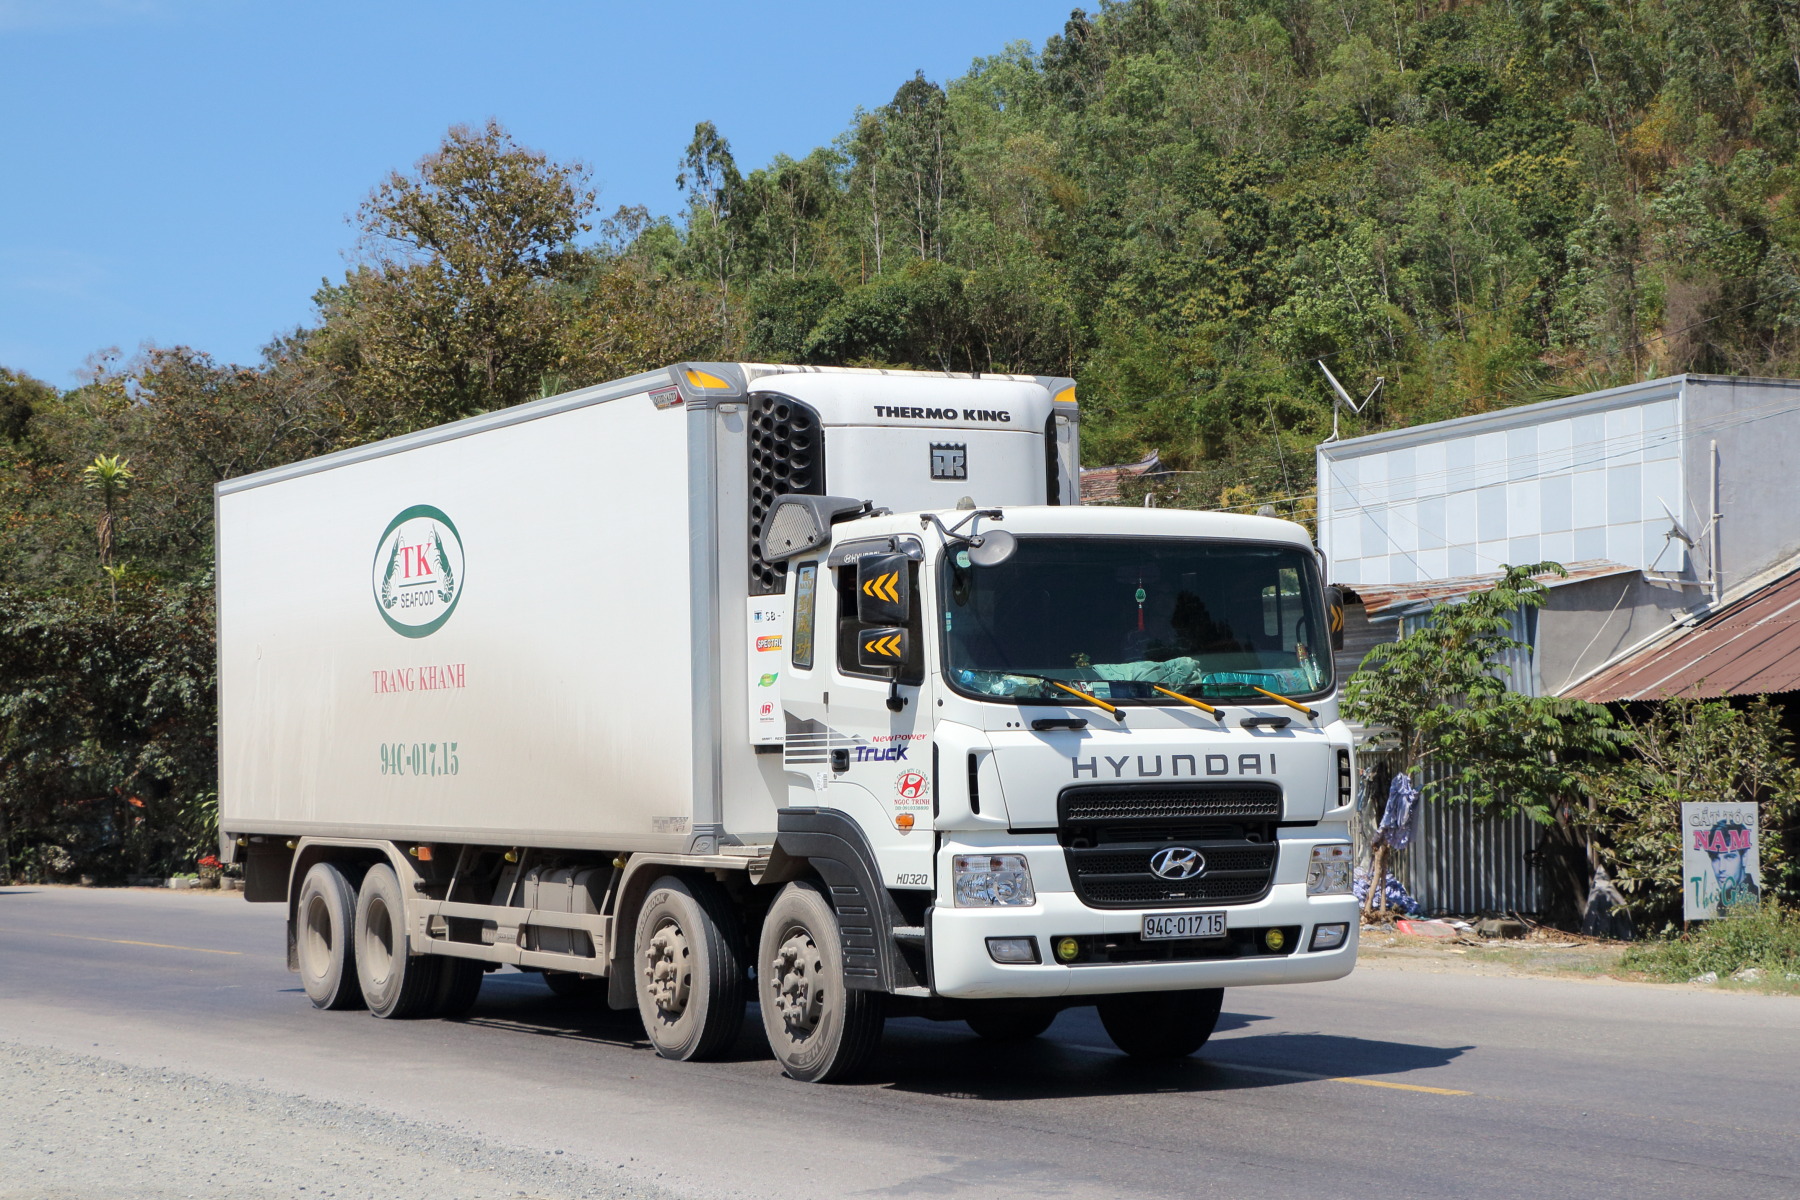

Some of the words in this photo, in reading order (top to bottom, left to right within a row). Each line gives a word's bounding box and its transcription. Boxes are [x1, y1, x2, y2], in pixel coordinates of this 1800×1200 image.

[874, 406, 958, 420] THERMO
[963, 409, 1011, 422] KING
[400, 543, 433, 578] TK
[401, 590, 435, 608] SEAFOOD
[373, 668, 414, 693] TRANG
[419, 664, 465, 690] KHANH
[761, 704, 772, 714] IR
[380, 742, 459, 777] 94C-017.15
[855, 744, 909, 762] Truck
[1072, 754, 1277, 778] HYUNDAI
[1723, 809, 1754, 826] TÓC
[1693, 829, 1753, 853] NAM
[896, 873, 928, 885] HD320
